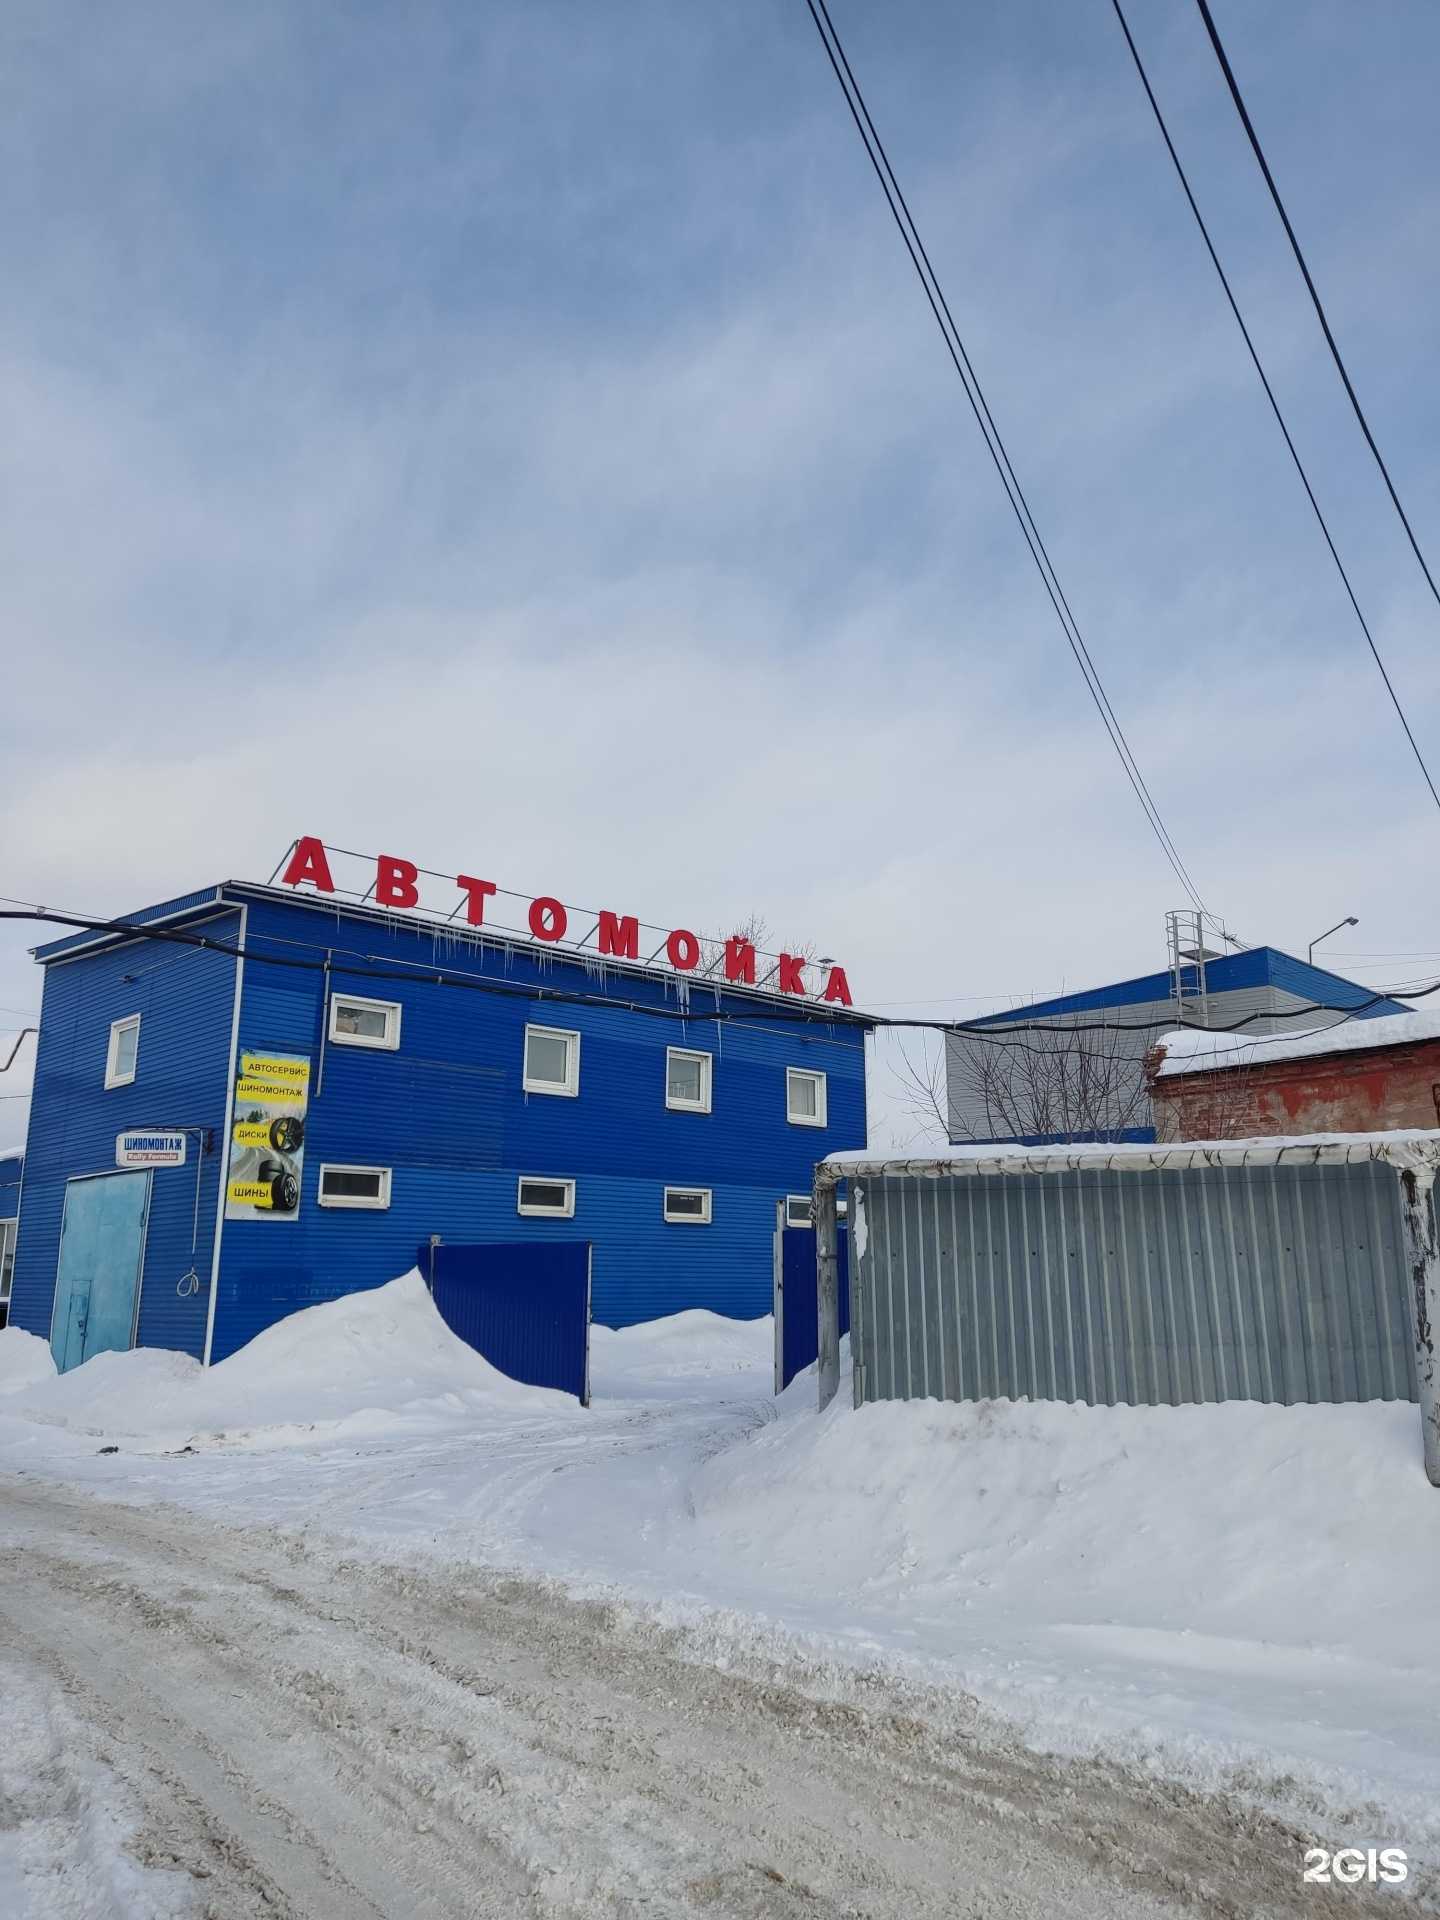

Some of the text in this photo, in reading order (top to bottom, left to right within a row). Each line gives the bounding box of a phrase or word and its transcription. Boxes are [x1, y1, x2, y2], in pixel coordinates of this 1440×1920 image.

[282, 836, 853, 1006] АВТОМОЙКА
[248, 1063, 308, 1077] АВТОСЕРВИС
[238, 1083, 303, 1097] ШИНОМОНТАЖ
[238, 1130, 267, 1139] ДИСКИ
[124, 1137, 182, 1150] ШИНОМОНТАЖ
[234, 1188, 269, 1198] ШИНЫ
